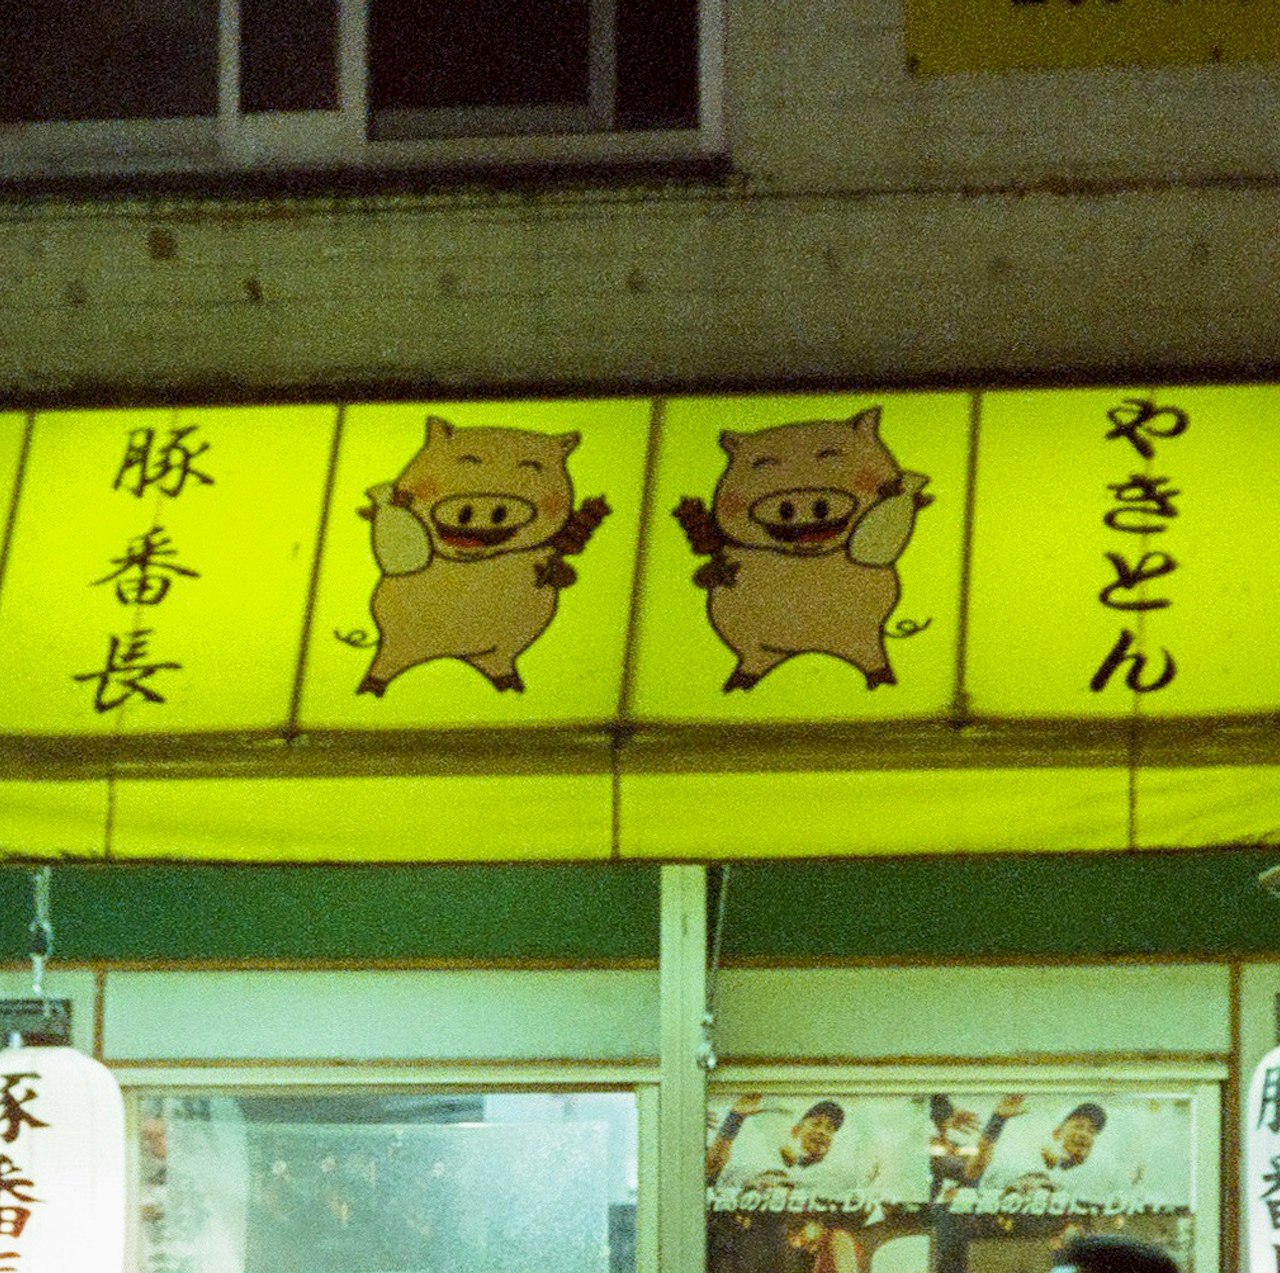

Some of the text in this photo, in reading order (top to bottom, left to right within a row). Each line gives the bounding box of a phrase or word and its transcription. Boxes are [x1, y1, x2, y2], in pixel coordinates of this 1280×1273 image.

[73, 424, 216, 714] 豚番長
[1088, 397, 1191, 694] やきとん
